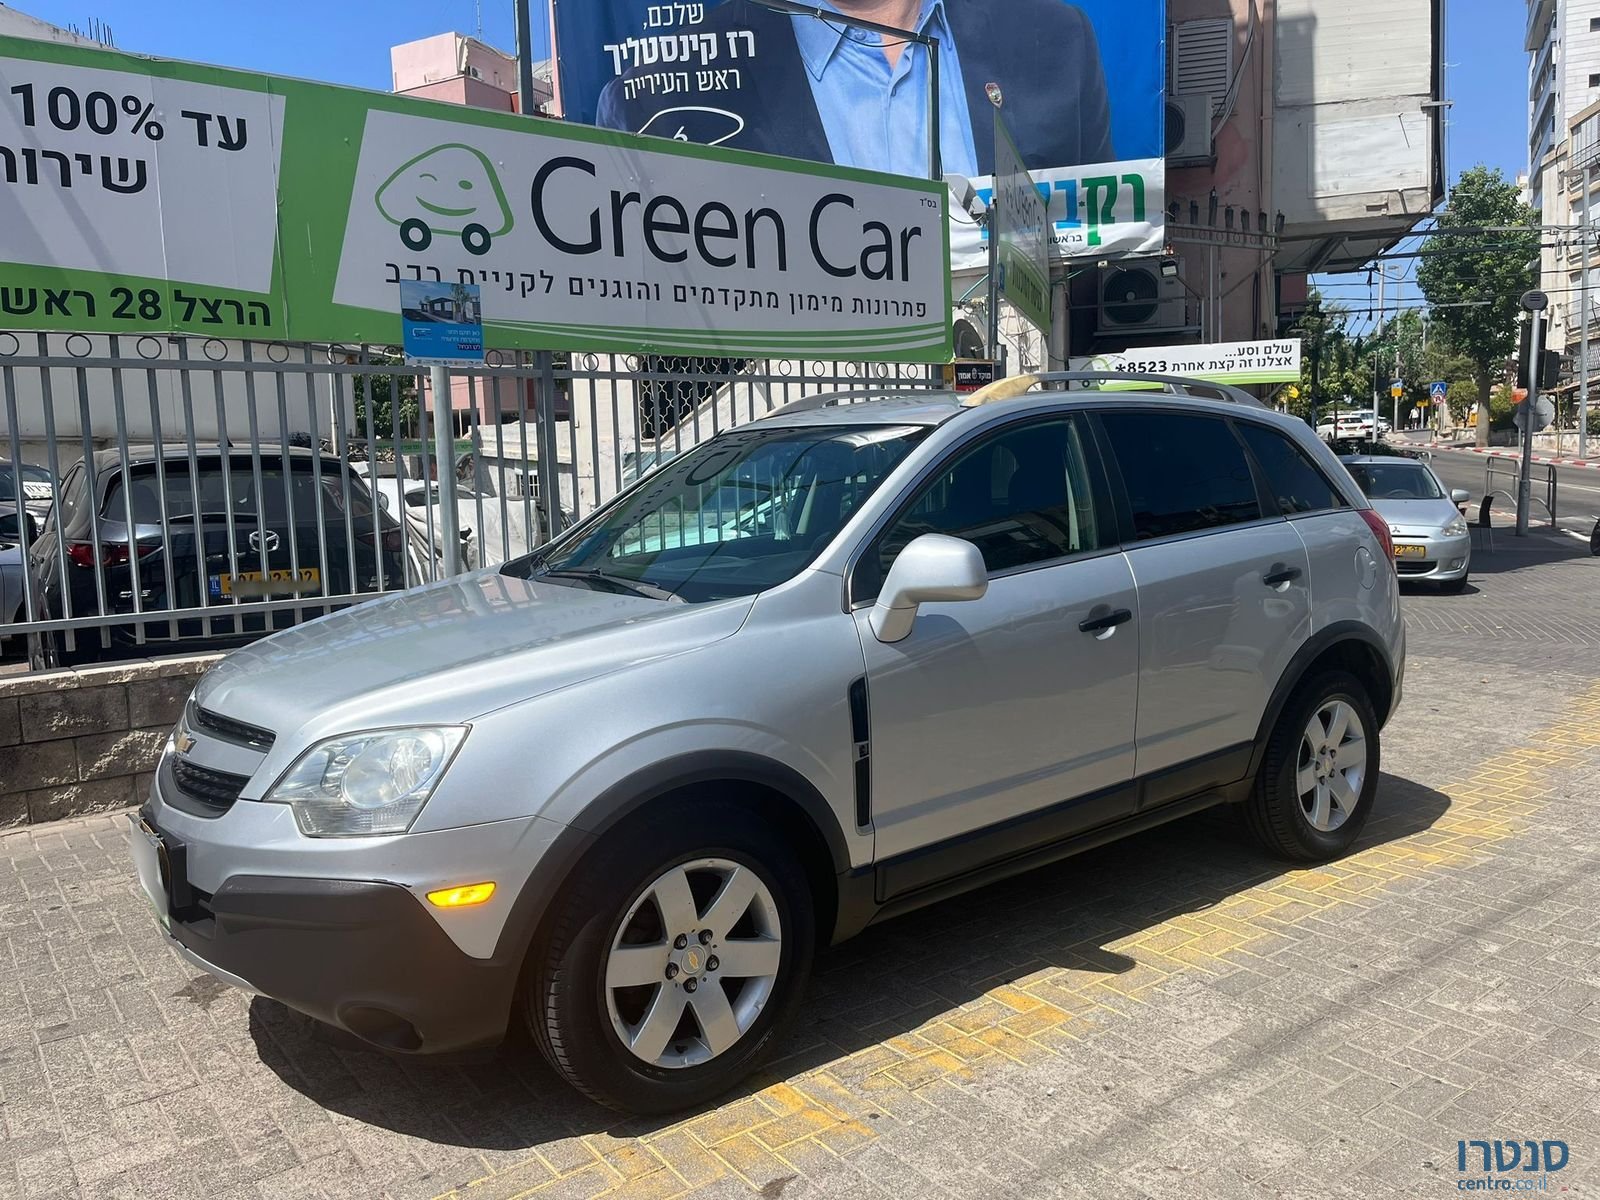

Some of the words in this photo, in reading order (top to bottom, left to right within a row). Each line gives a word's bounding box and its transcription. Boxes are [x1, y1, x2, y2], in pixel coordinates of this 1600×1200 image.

[643, 2, 704, 30] שלכם,
[603, 33, 718, 76] קינסטליך
[726, 31, 756, 59] רז
[623, 71, 689, 100] העירייה
[695, 69, 741, 92] ראש
[11, 83, 164, 141] 100%
[181, 110, 248, 152] עד
[531, 156, 787, 272] Green
[809, 193, 922, 282] Car
[1047, 234, 1083, 246] בראשו
[457, 268, 554, 298] לקניית
[568, 276, 661, 301] והוגנים
[110, 287, 162, 321] 28
[173, 289, 271, 327] הרצל
[673, 285, 779, 312] מתקדמים
[789, 292, 843, 315] מימון
[851, 297, 927, 318] פתרונות
[1225, 346, 1259, 357] וסע...
[1257, 355, 1293, 366] אצלנו
[1263, 343, 1293, 355] שלם
[1171, 361, 1205, 372] אחרת
[1208, 359, 1235, 371] קצת
[1239, 359, 1253, 368] זה
